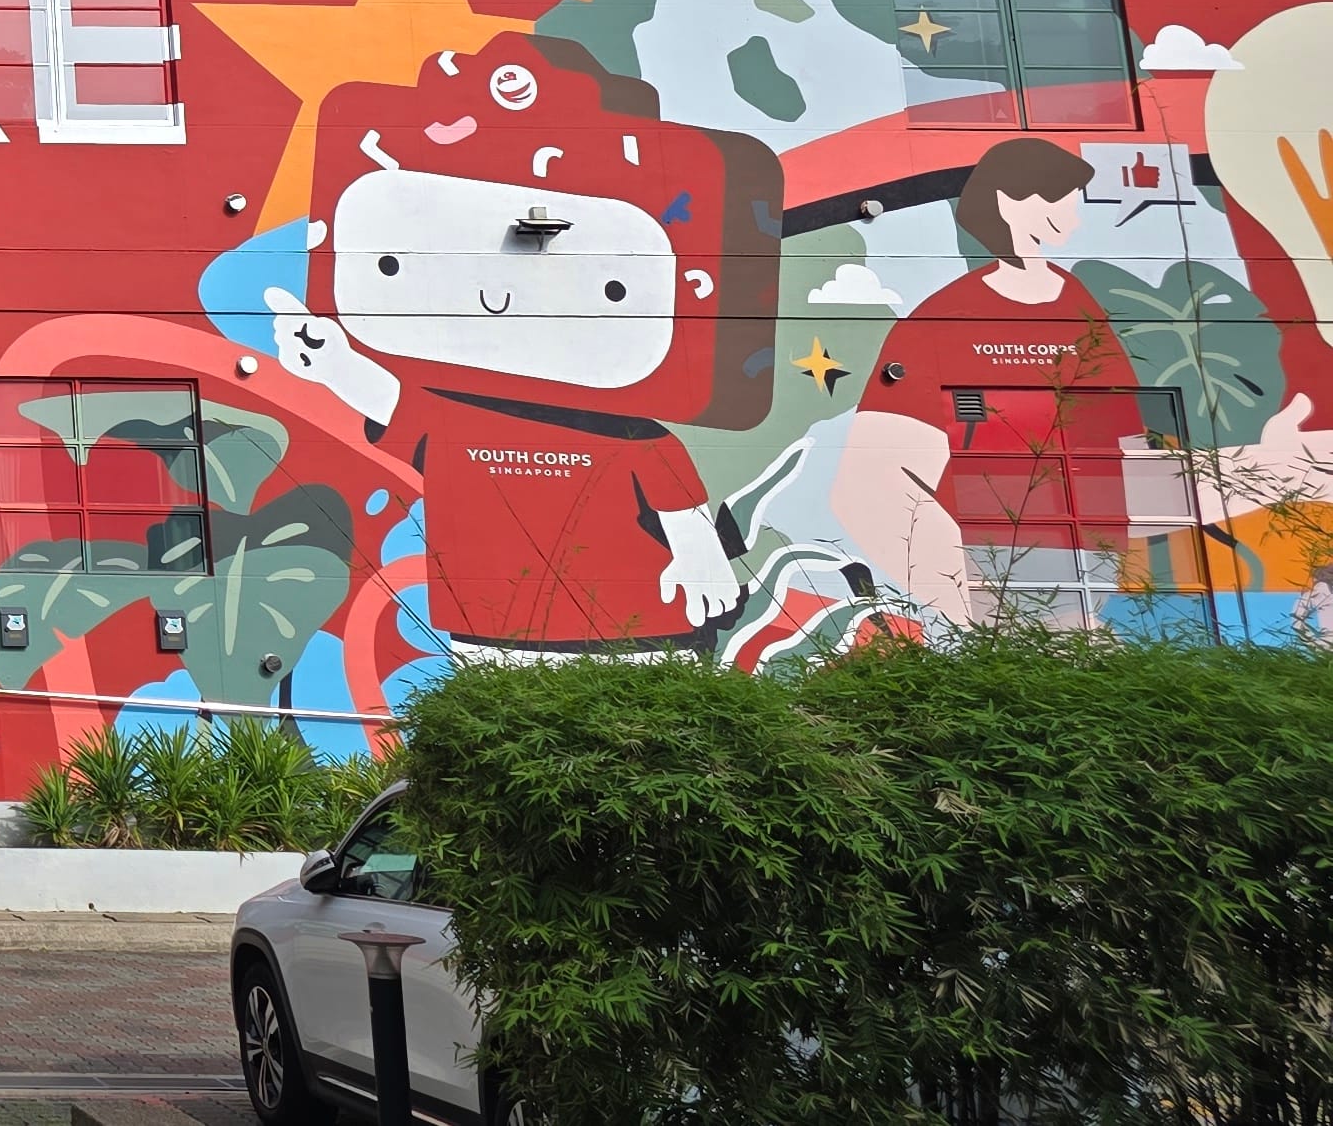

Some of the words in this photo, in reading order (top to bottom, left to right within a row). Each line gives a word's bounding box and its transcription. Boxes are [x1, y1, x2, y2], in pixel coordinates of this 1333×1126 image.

[972, 343, 1025, 356] YOUTH
[1027, 344, 1078, 356] CORPS
[992, 357, 1053, 365] SINGAPOR
[466, 448, 529, 464] YOUTH
[533, 452, 592, 467] CORPS
[489, 466, 572, 478] SINGAPORE
